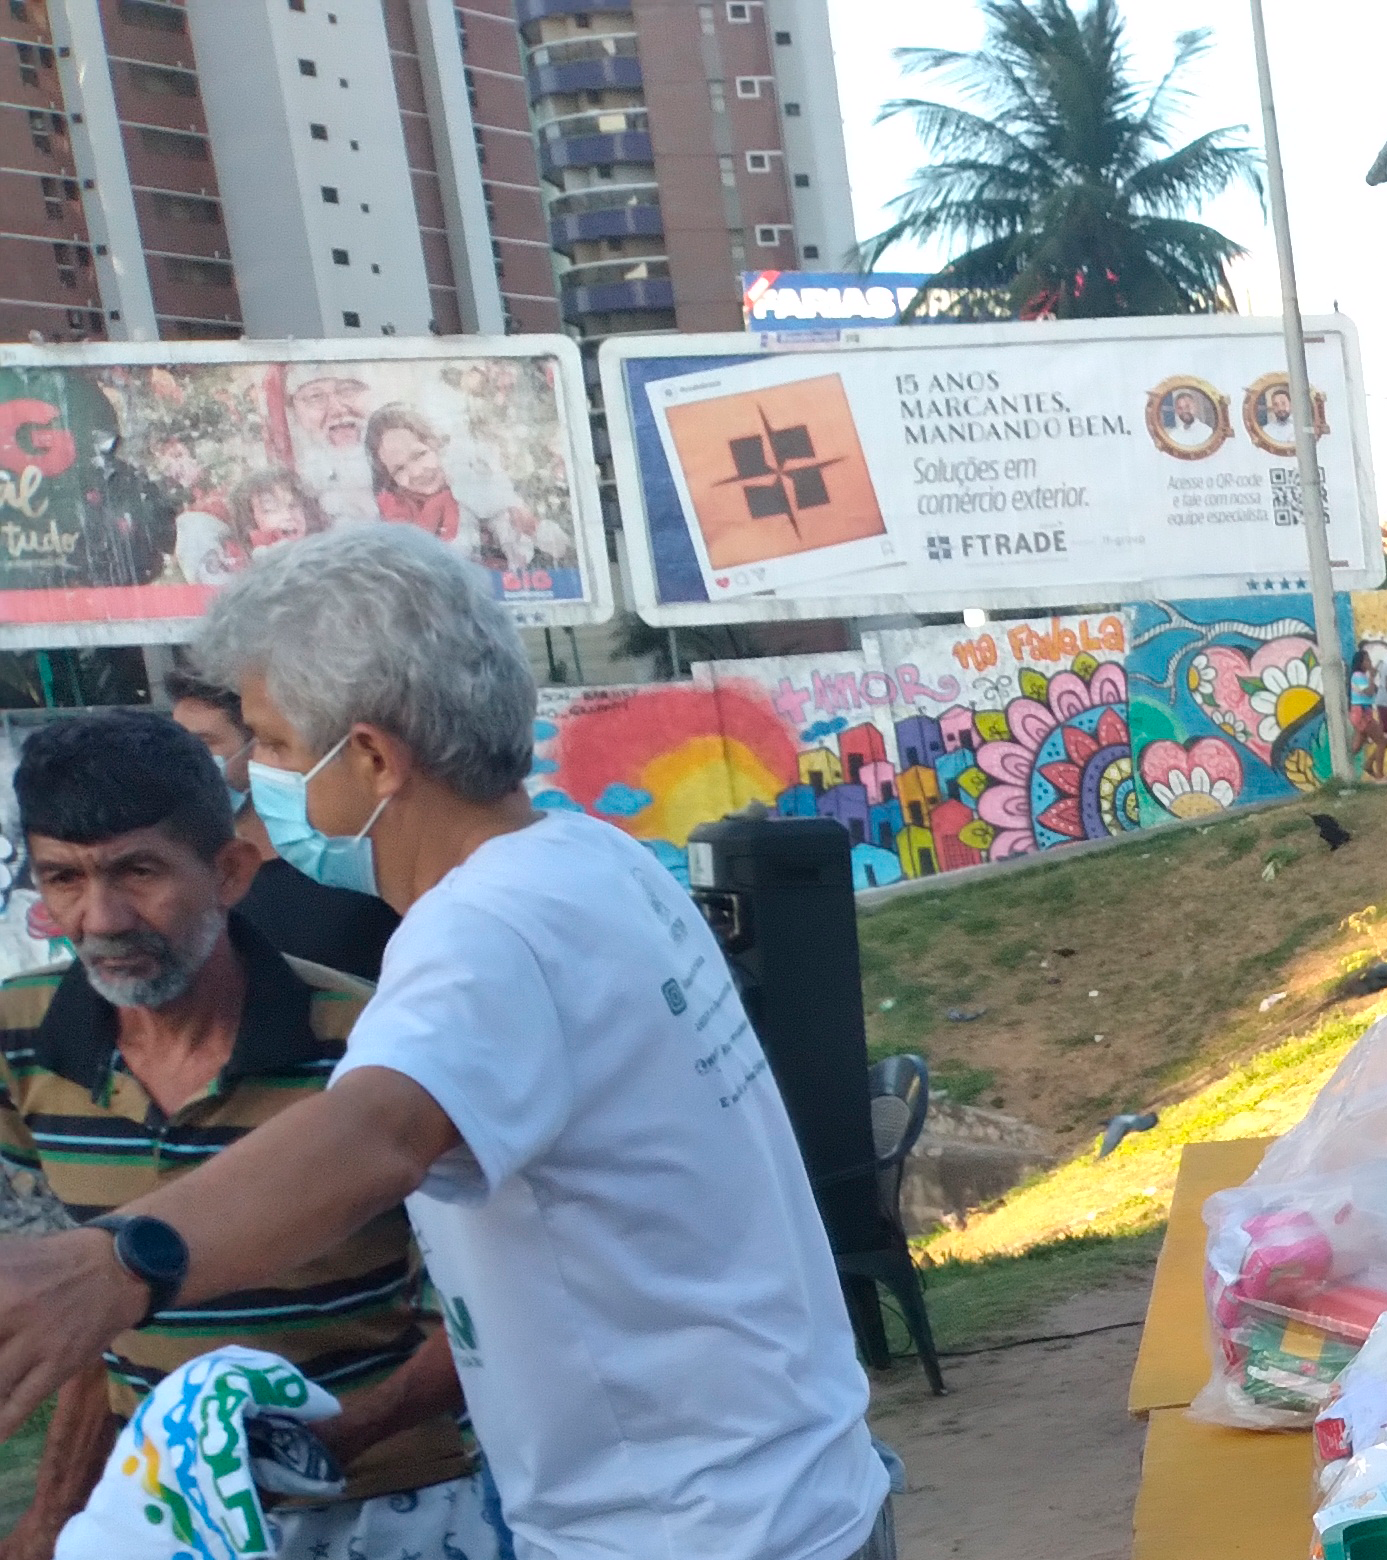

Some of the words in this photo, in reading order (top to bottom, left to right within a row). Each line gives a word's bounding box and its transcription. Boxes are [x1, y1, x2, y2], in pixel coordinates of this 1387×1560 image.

[895, 373, 919, 396] 15
[928, 370, 1000, 394] ANOS
[900, 391, 1071, 419] MARCANTES.
[904, 417, 1062, 445] MANDANDO
[1068, 414, 1132, 438] BEM.
[913, 456, 1000, 487] Soluções
[1004, 456, 1037, 481] em
[917, 485, 1008, 516] comércio
[1011, 482, 1090, 513] exterior.
[961, 530, 1068, 557] FTRADE
